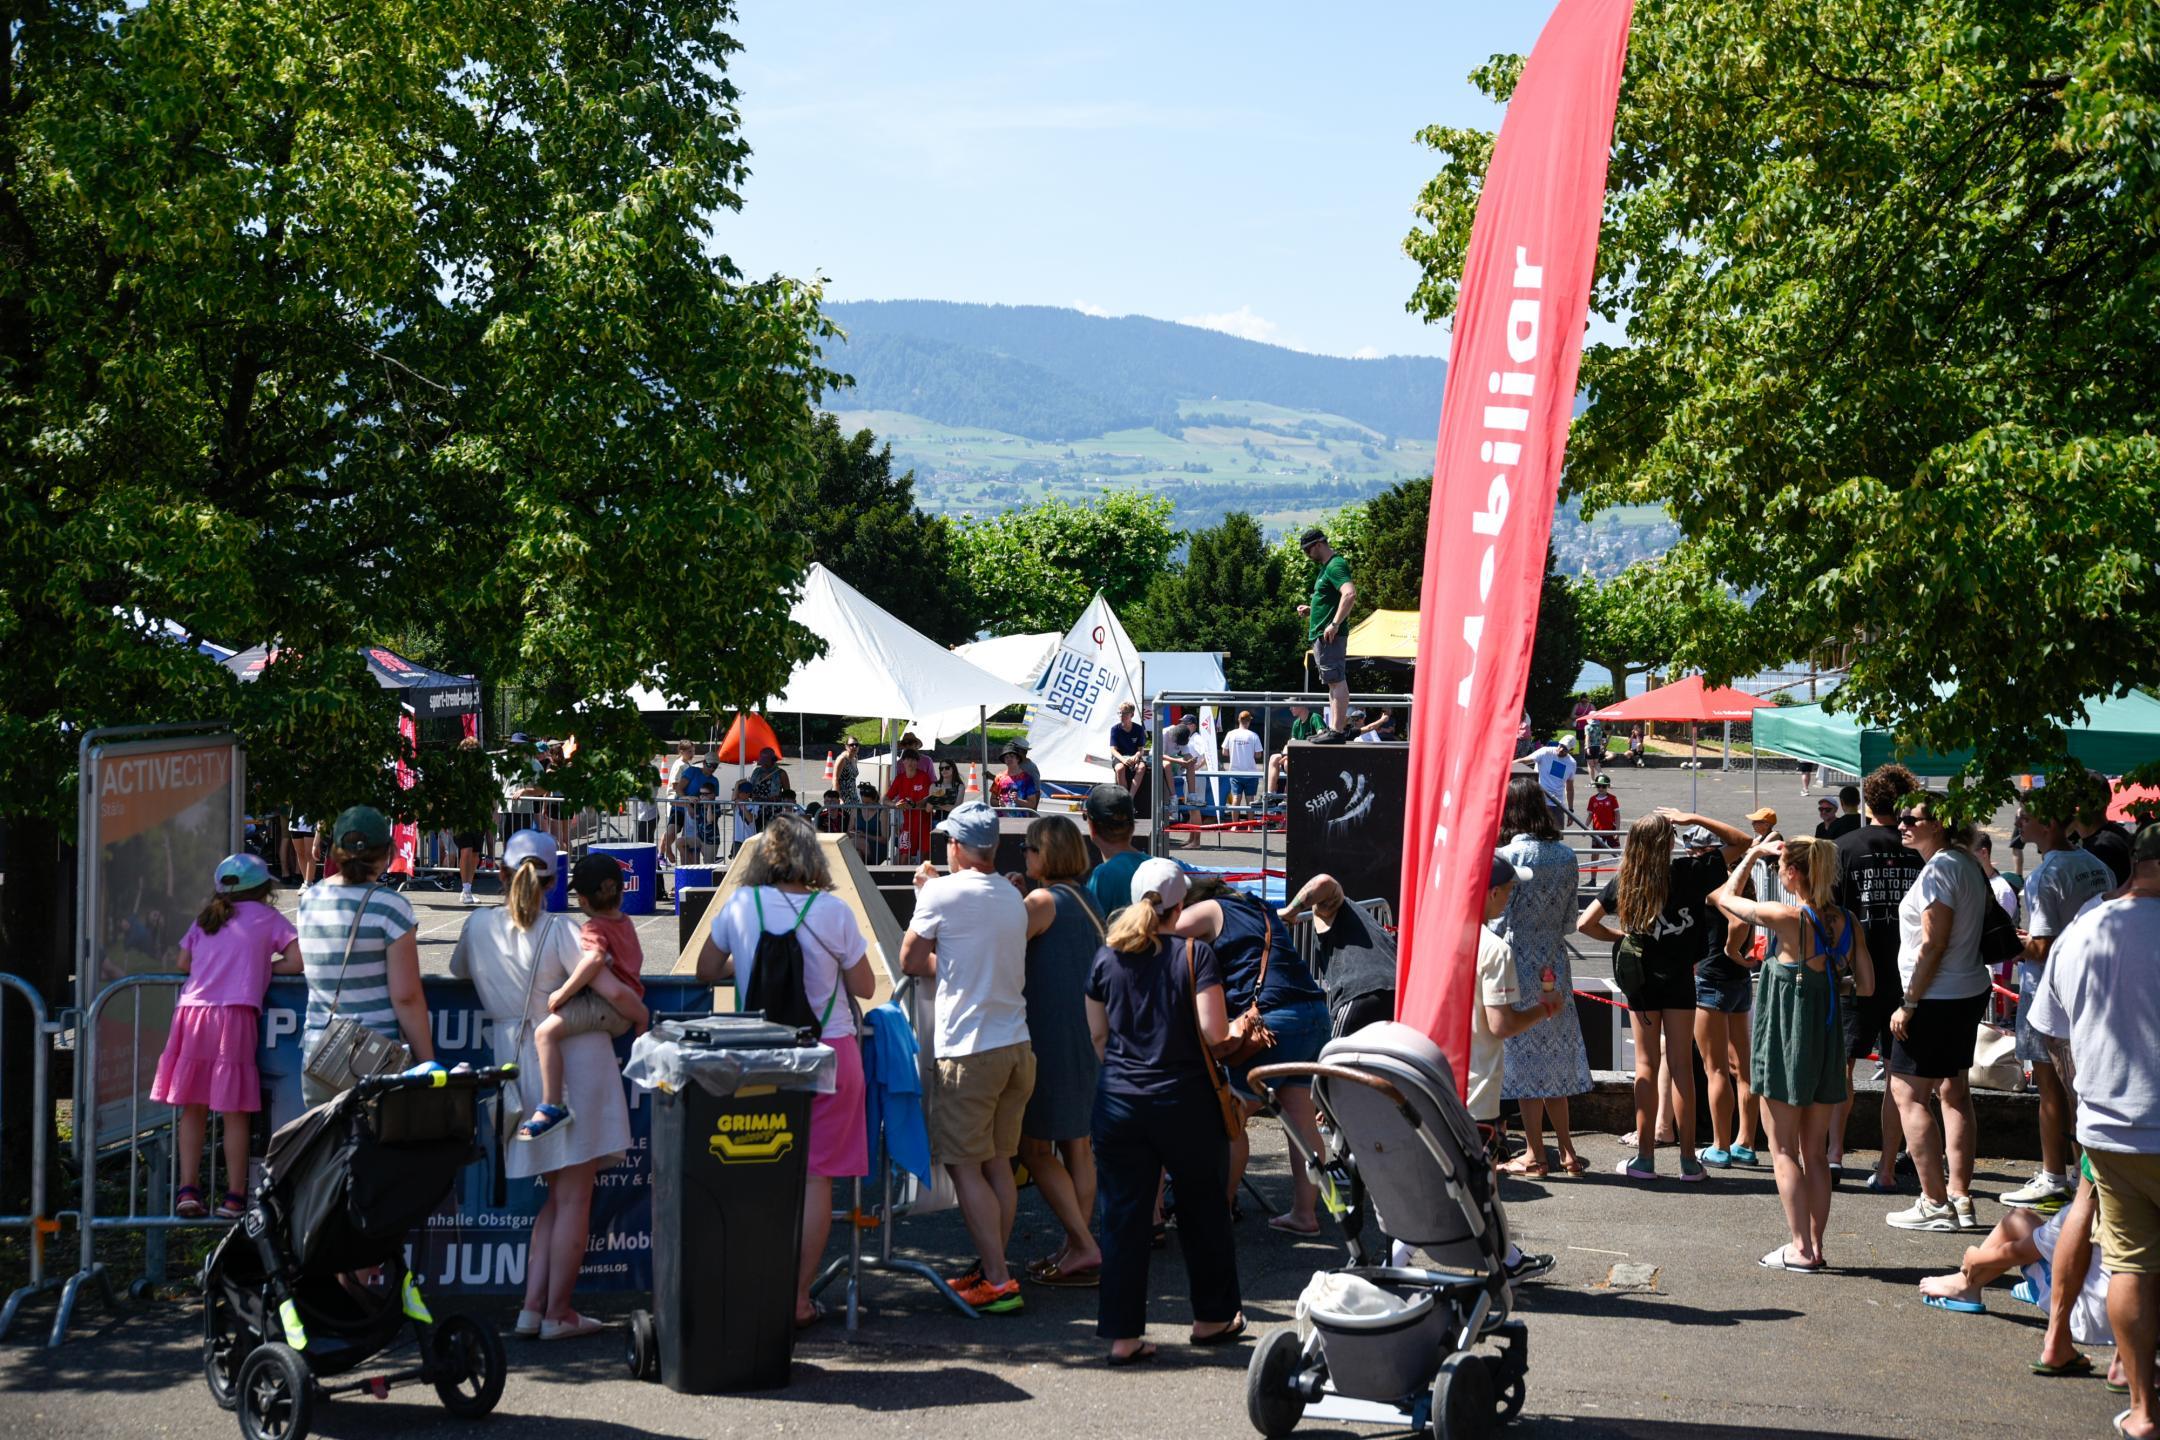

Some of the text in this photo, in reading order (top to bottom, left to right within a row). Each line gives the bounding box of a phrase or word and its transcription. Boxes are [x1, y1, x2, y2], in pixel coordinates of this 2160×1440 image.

[1053, 671, 1100, 705] 1583
[429, 687, 480, 713] sport-trend-shopch
[1305, 789, 1339, 813] Stäfa
[1862, 868, 1880, 879] YOU
[1882, 867, 1901, 878] GET
[623, 875, 640, 892] ull
[1887, 880, 1900, 889] TO
[1889, 890, 1900, 901] TO
[717, 1112, 787, 1132] GRIMM
[632, 1173, 643, 1186] &
[427, 1213, 536, 1229] nhalle Obstgar
[607, 1230, 654, 1251] Mobi
[439, 1243, 527, 1286] JUN
[578, 1263, 630, 1275] SWISSLOS
